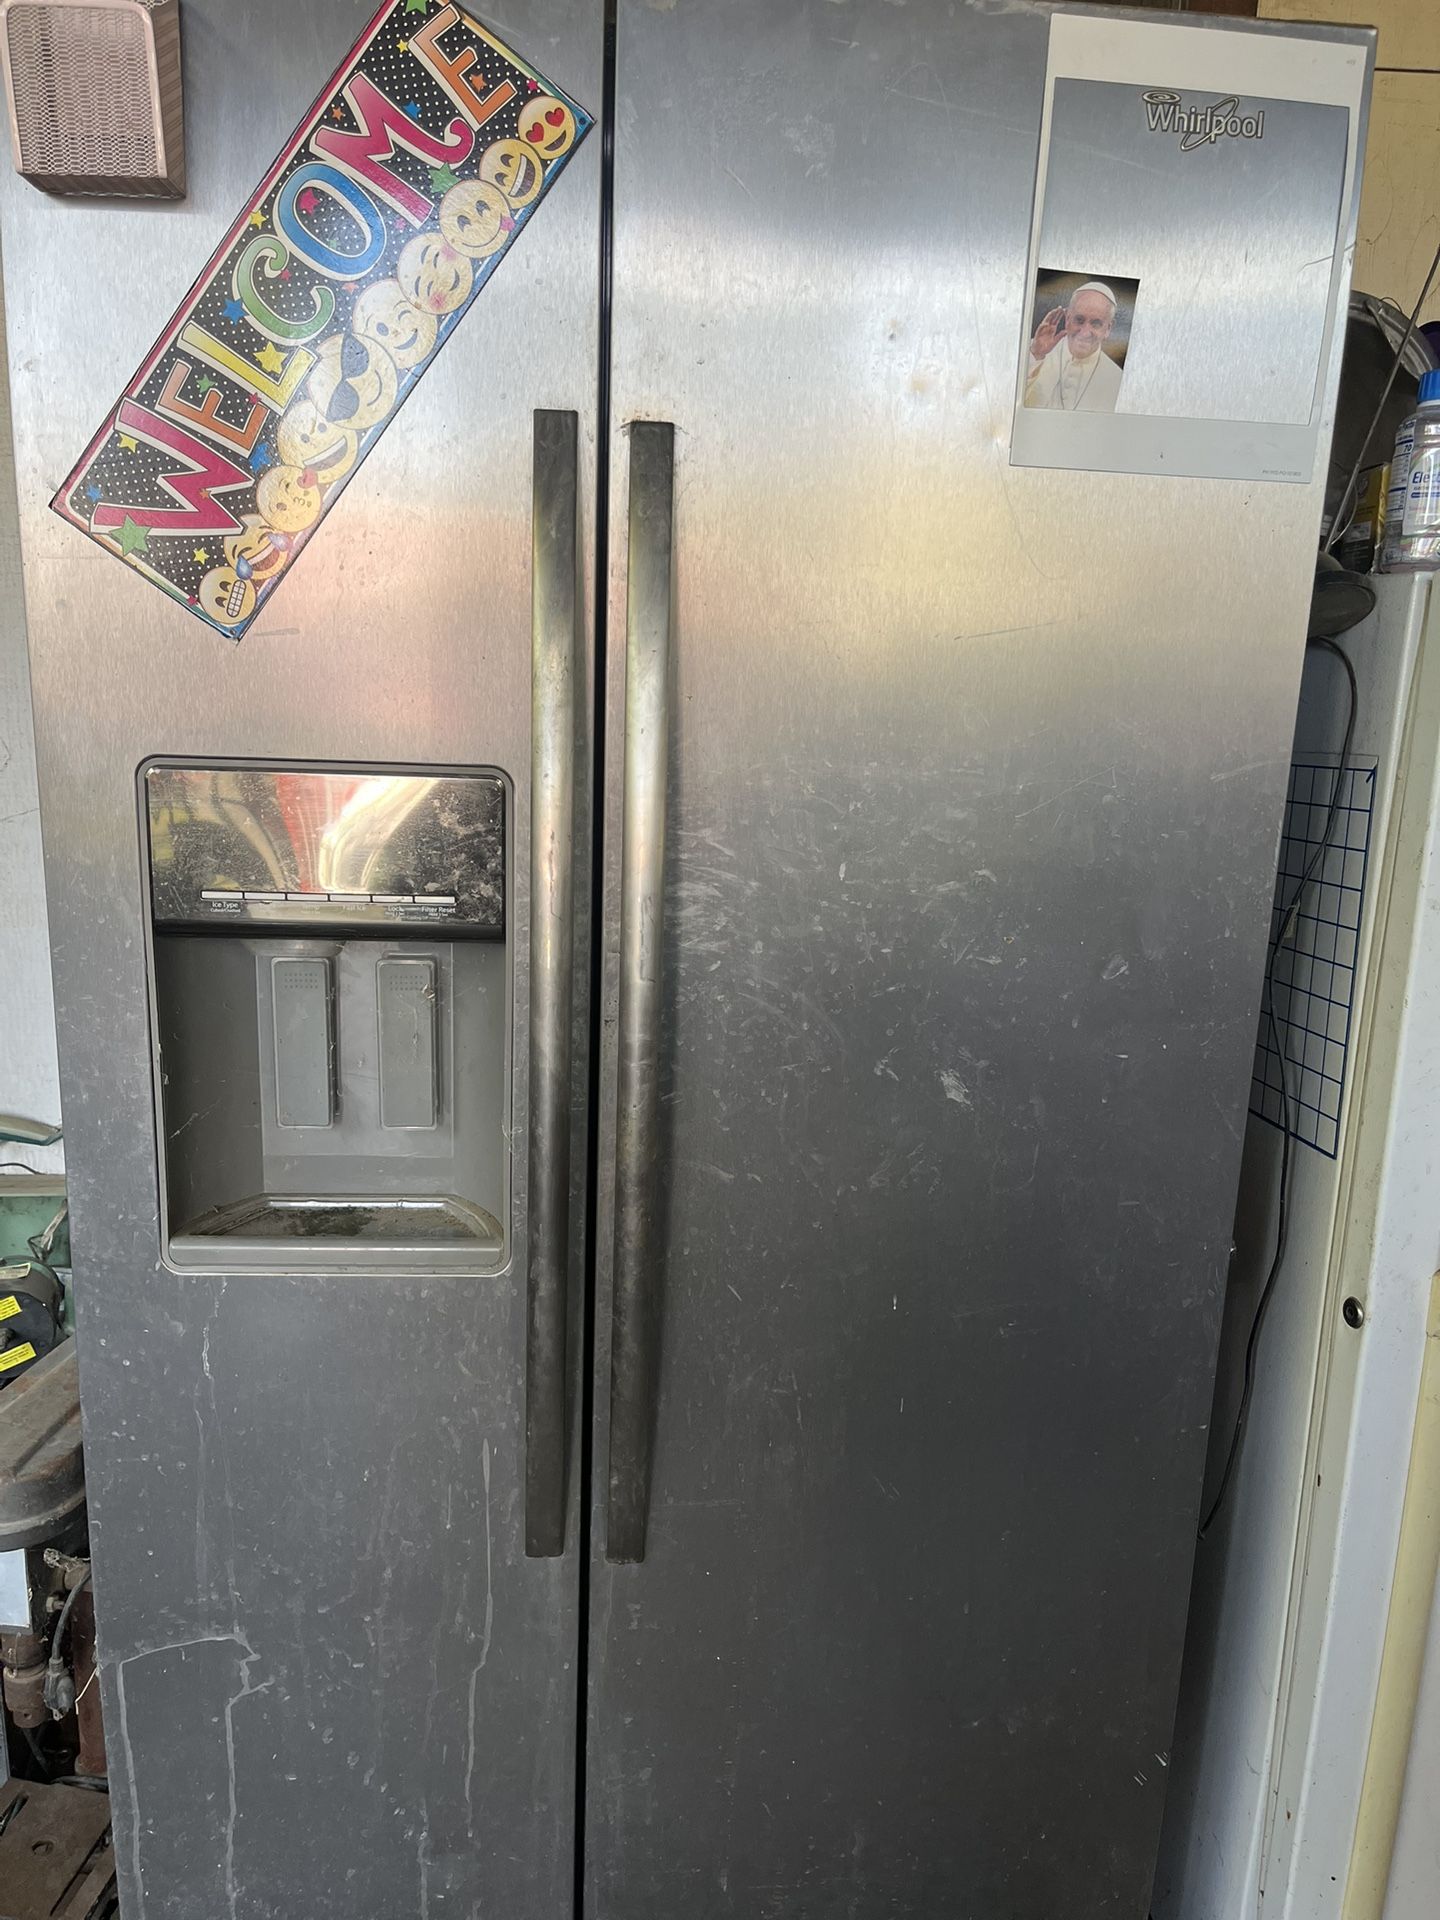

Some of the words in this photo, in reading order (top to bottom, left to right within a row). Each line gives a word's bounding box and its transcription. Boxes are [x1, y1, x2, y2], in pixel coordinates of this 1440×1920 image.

[1144, 100, 1265, 145] Whirlpool
[89, 4, 518, 537] WELCOME
[223, 901, 239, 910] Type
